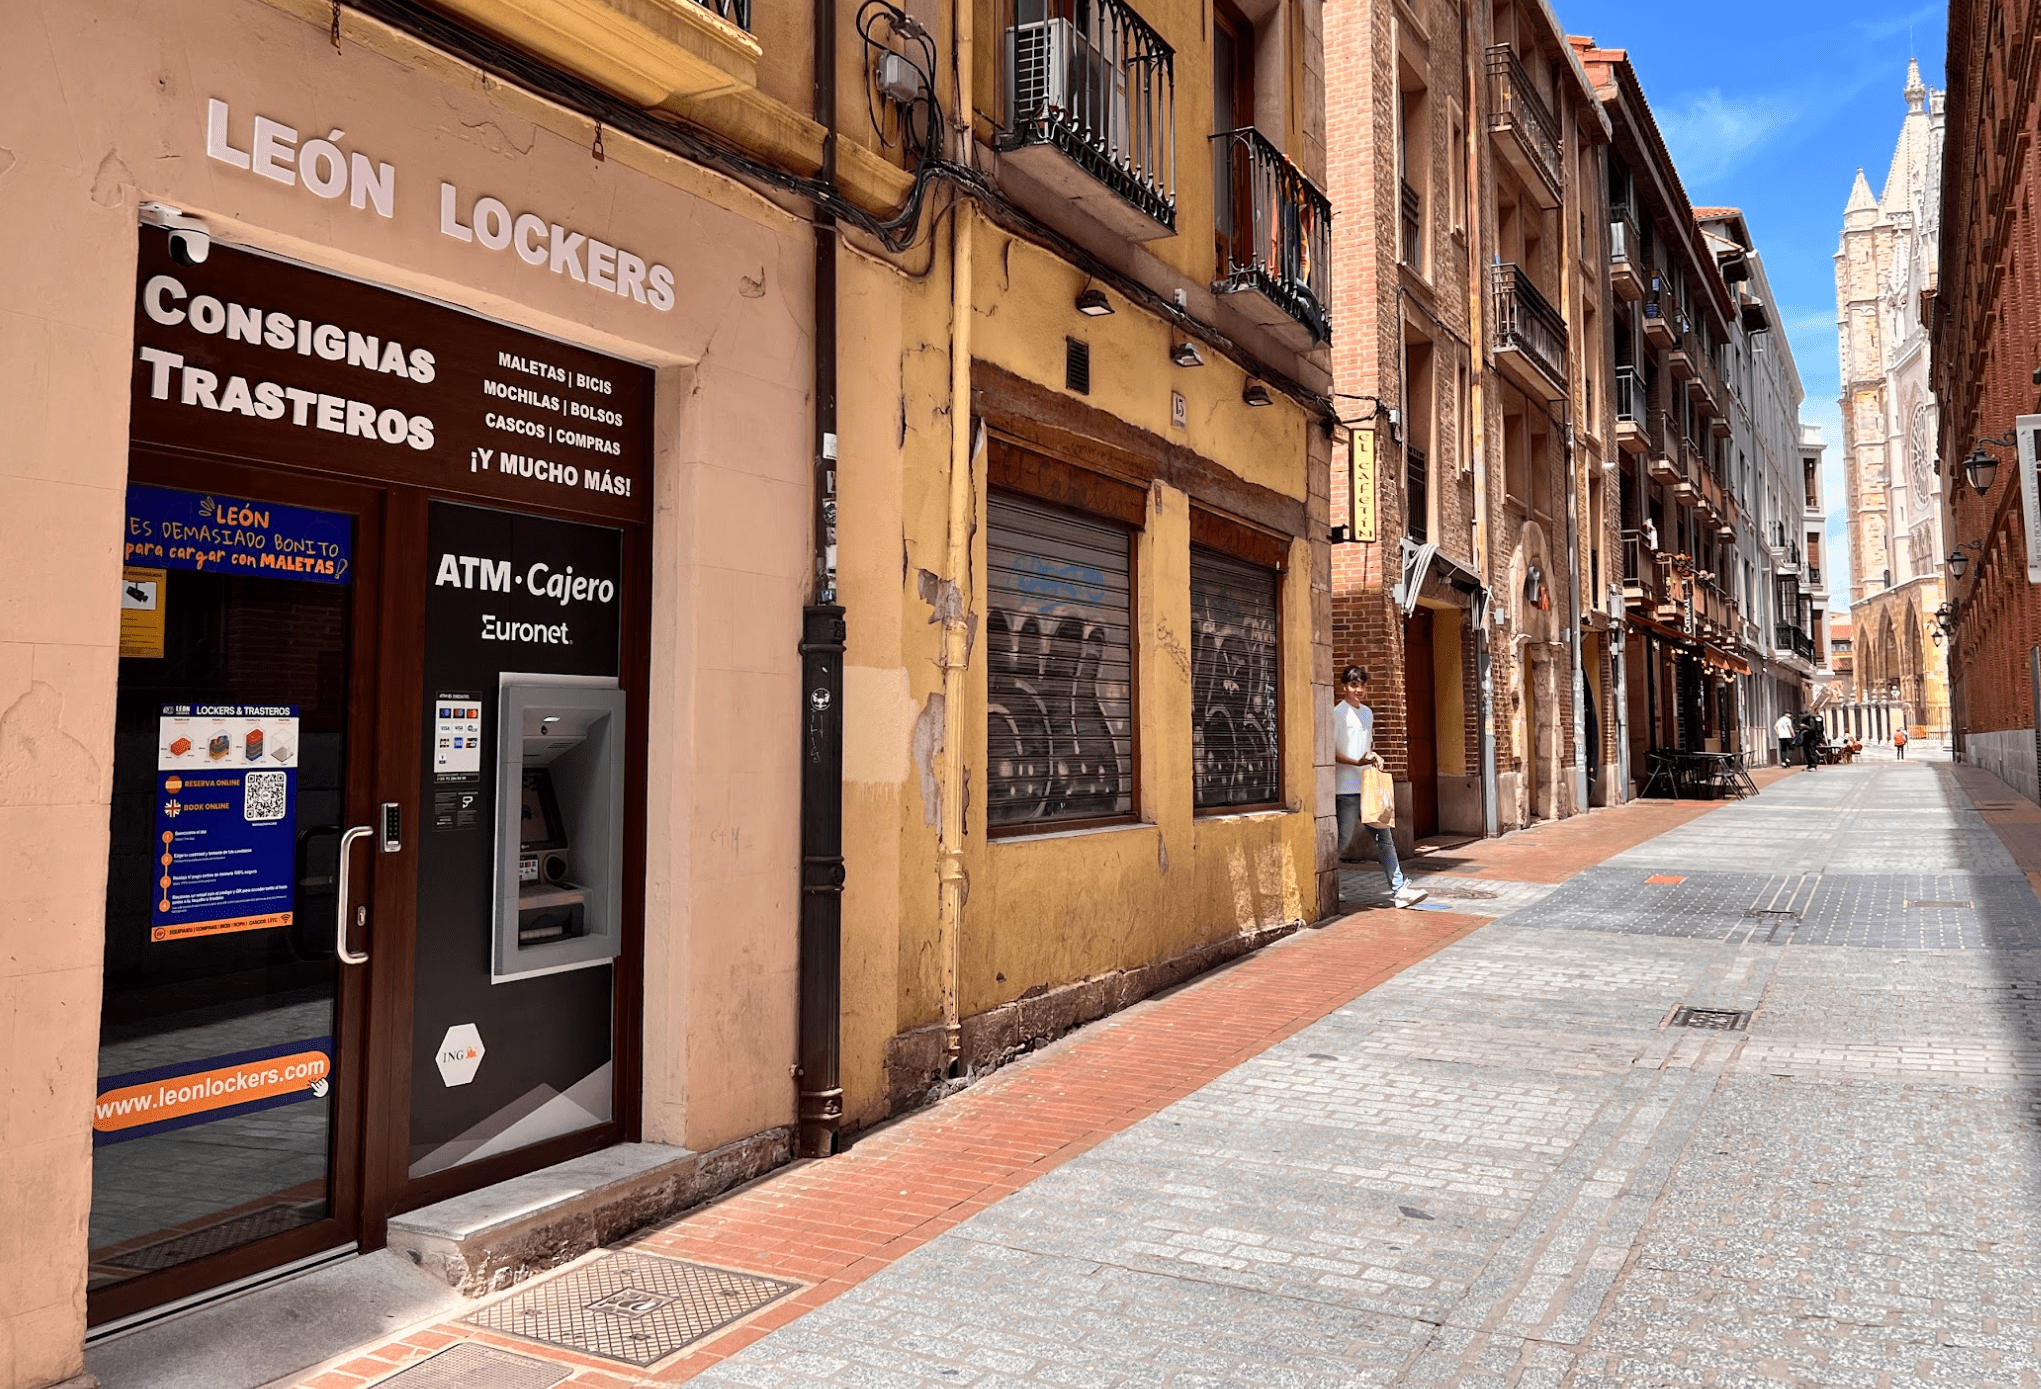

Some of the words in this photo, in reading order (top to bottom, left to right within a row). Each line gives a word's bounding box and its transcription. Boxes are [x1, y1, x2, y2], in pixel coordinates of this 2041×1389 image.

[207, 98, 395, 219] LEÓN
[440, 182, 675, 311] LOCKERS
[143, 274, 436, 384] CONSIGNAS
[498, 352, 566, 384] MALETAS
[576, 372, 612, 395] BICIS
[140, 346, 435, 450] TRASTEROS
[484, 380, 560, 413] MOCHILAS
[570, 399, 623, 427] BOLSOS
[485, 412, 545, 440] CASCOS
[556, 427, 621, 456] COMPRAS
[470, 448, 491, 473] ¡Y
[500, 452, 578, 487] MUCHO
[584, 466, 631, 497] MÁS!
[130, 517, 152, 537] ES
[162, 522, 266, 549] DEMASIADO
[274, 532, 339, 558] BONITO
[216, 503, 269, 529] LEÓN
[124, 541, 164, 560] para
[169, 546, 226, 570] cargar
[231, 552, 257, 568] con
[481, 613, 570, 645] Euronet
[196, 706, 235, 716] LOCKERS
[236, 707, 243, 715] &
[244, 707, 291, 716] TRASTEROS
[443, 1050, 464, 1063] ING
[96, 1059, 325, 1121] www.leonlockers.com
